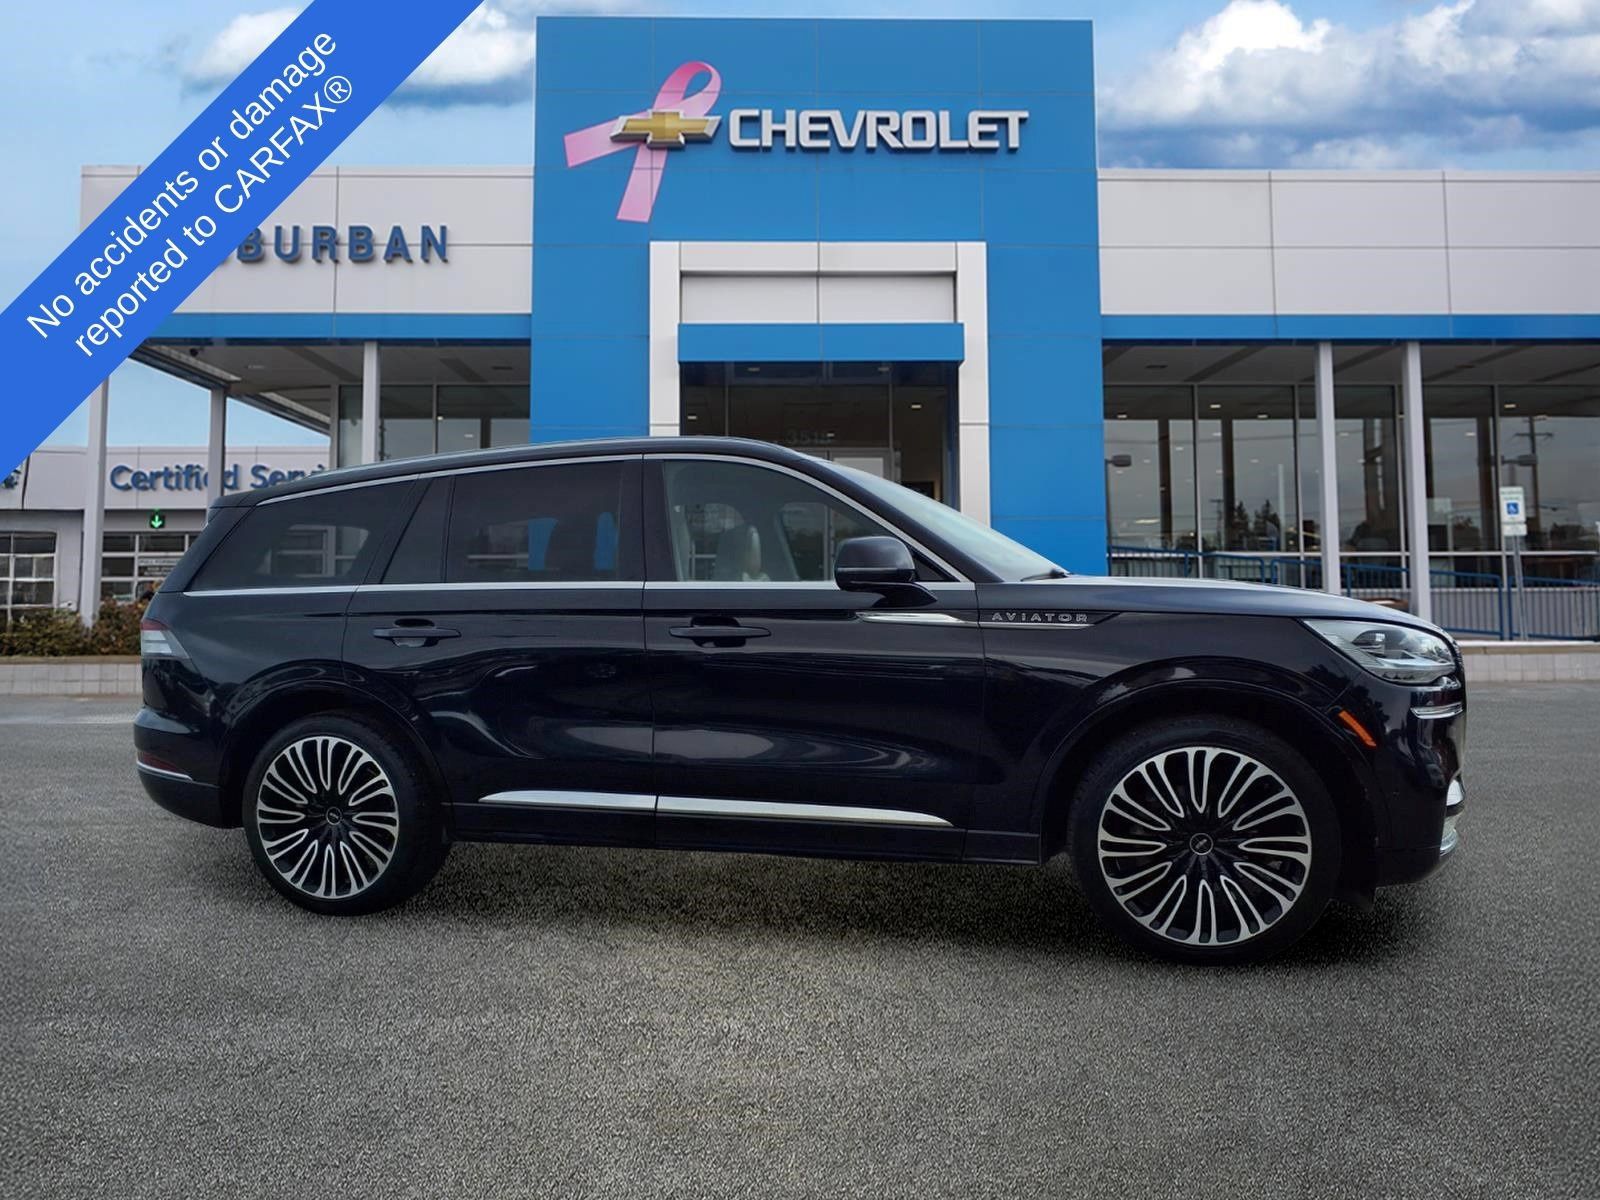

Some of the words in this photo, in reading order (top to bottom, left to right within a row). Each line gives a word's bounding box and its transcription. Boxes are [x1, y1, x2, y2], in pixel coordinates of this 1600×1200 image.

[729, 109, 1029, 150] CHEVROLET
[235, 225, 449, 264] BURBAN
[991, 611, 1088, 623] AVIATOR
